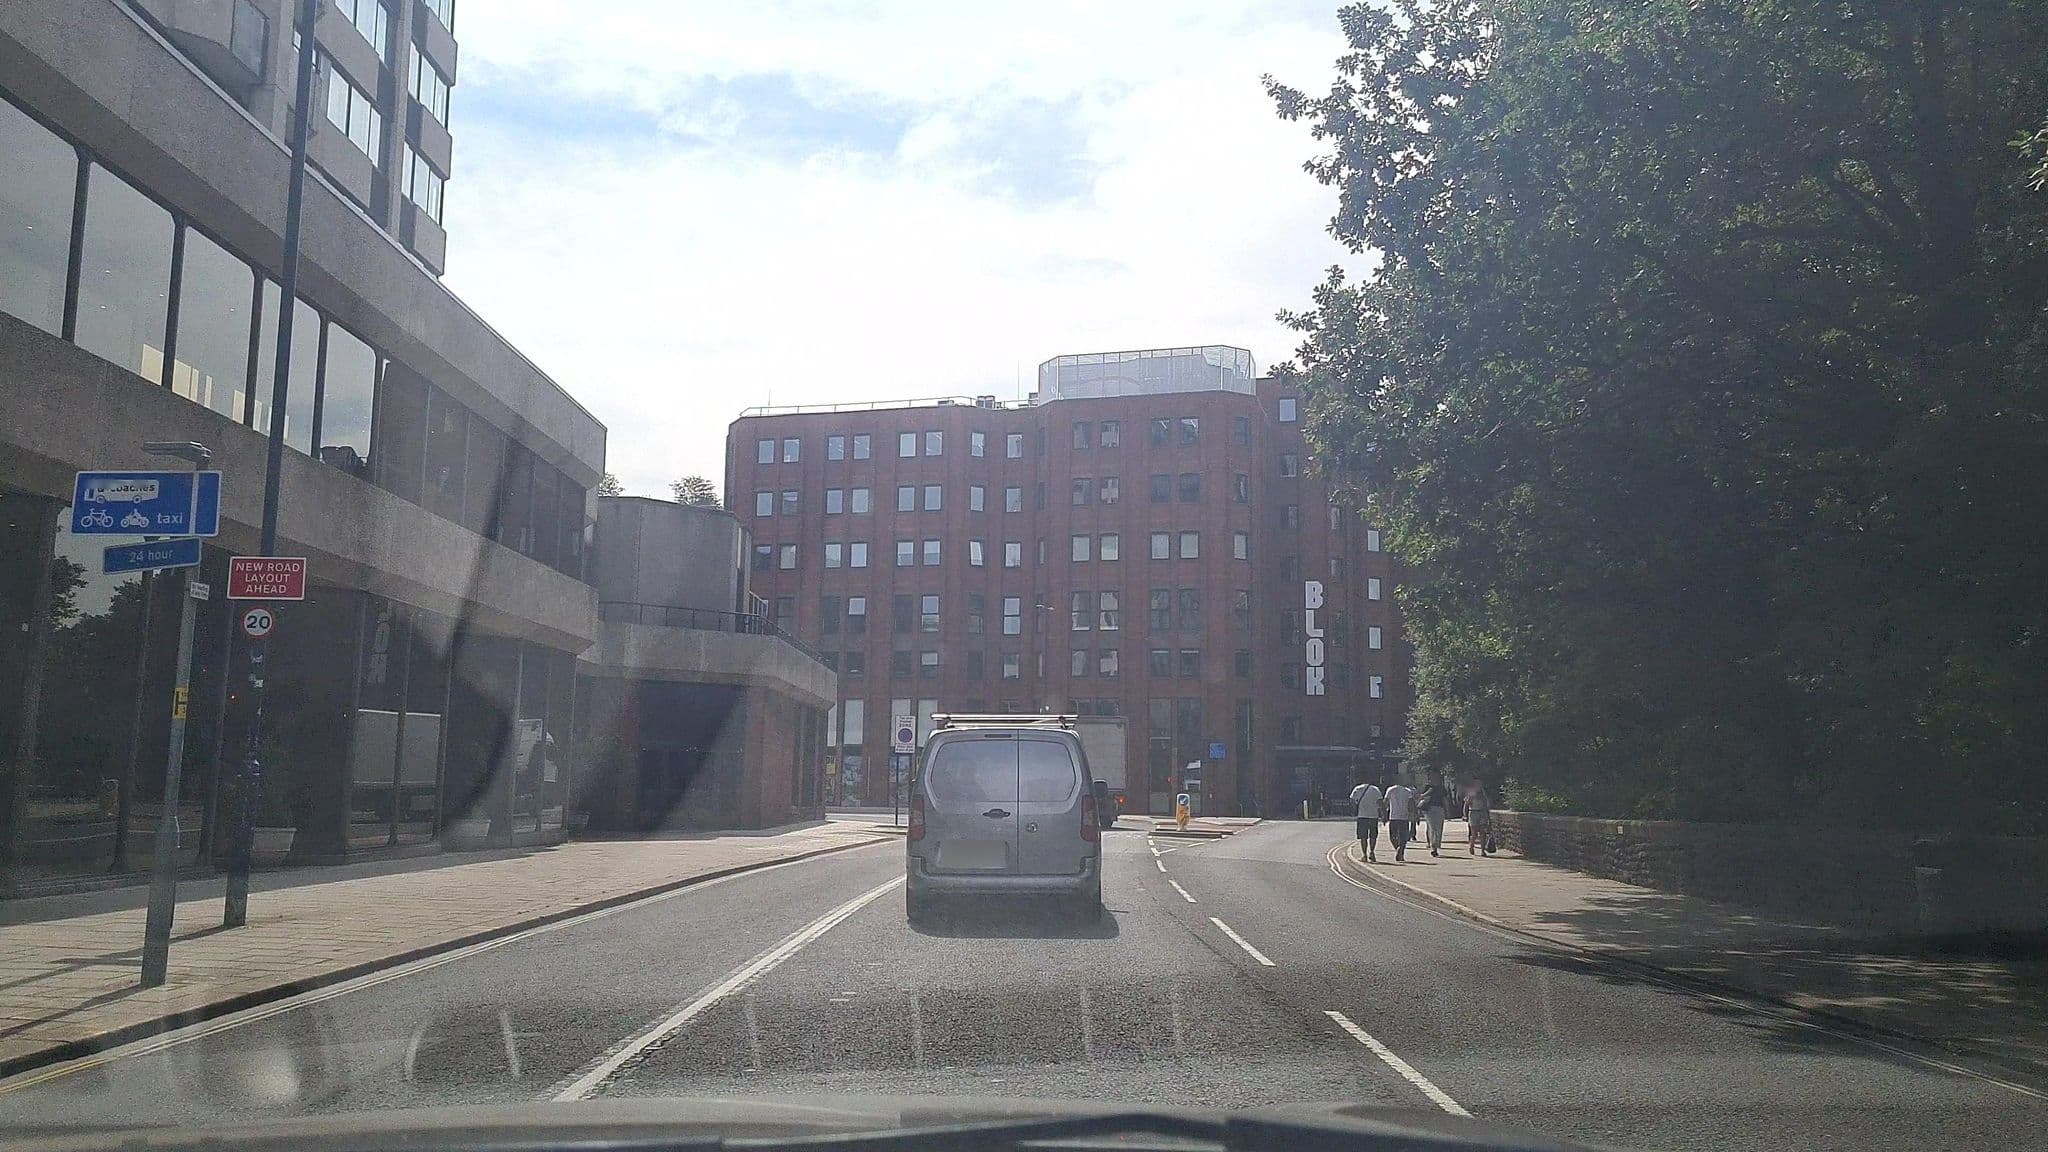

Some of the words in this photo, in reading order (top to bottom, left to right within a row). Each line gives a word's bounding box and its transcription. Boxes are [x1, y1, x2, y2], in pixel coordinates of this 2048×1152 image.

[157, 512, 183, 524] taxi
[129, 551, 145, 563] 24
[148, 550, 174, 561] hour
[235, 562, 263, 572] NEW
[267, 562, 300, 572] ROAD
[245, 573, 291, 583] LAYOUT
[245, 584, 287, 594] AHEAD
[246, 615, 271, 629] 20
[1305, 581, 1325, 695] BLOK
